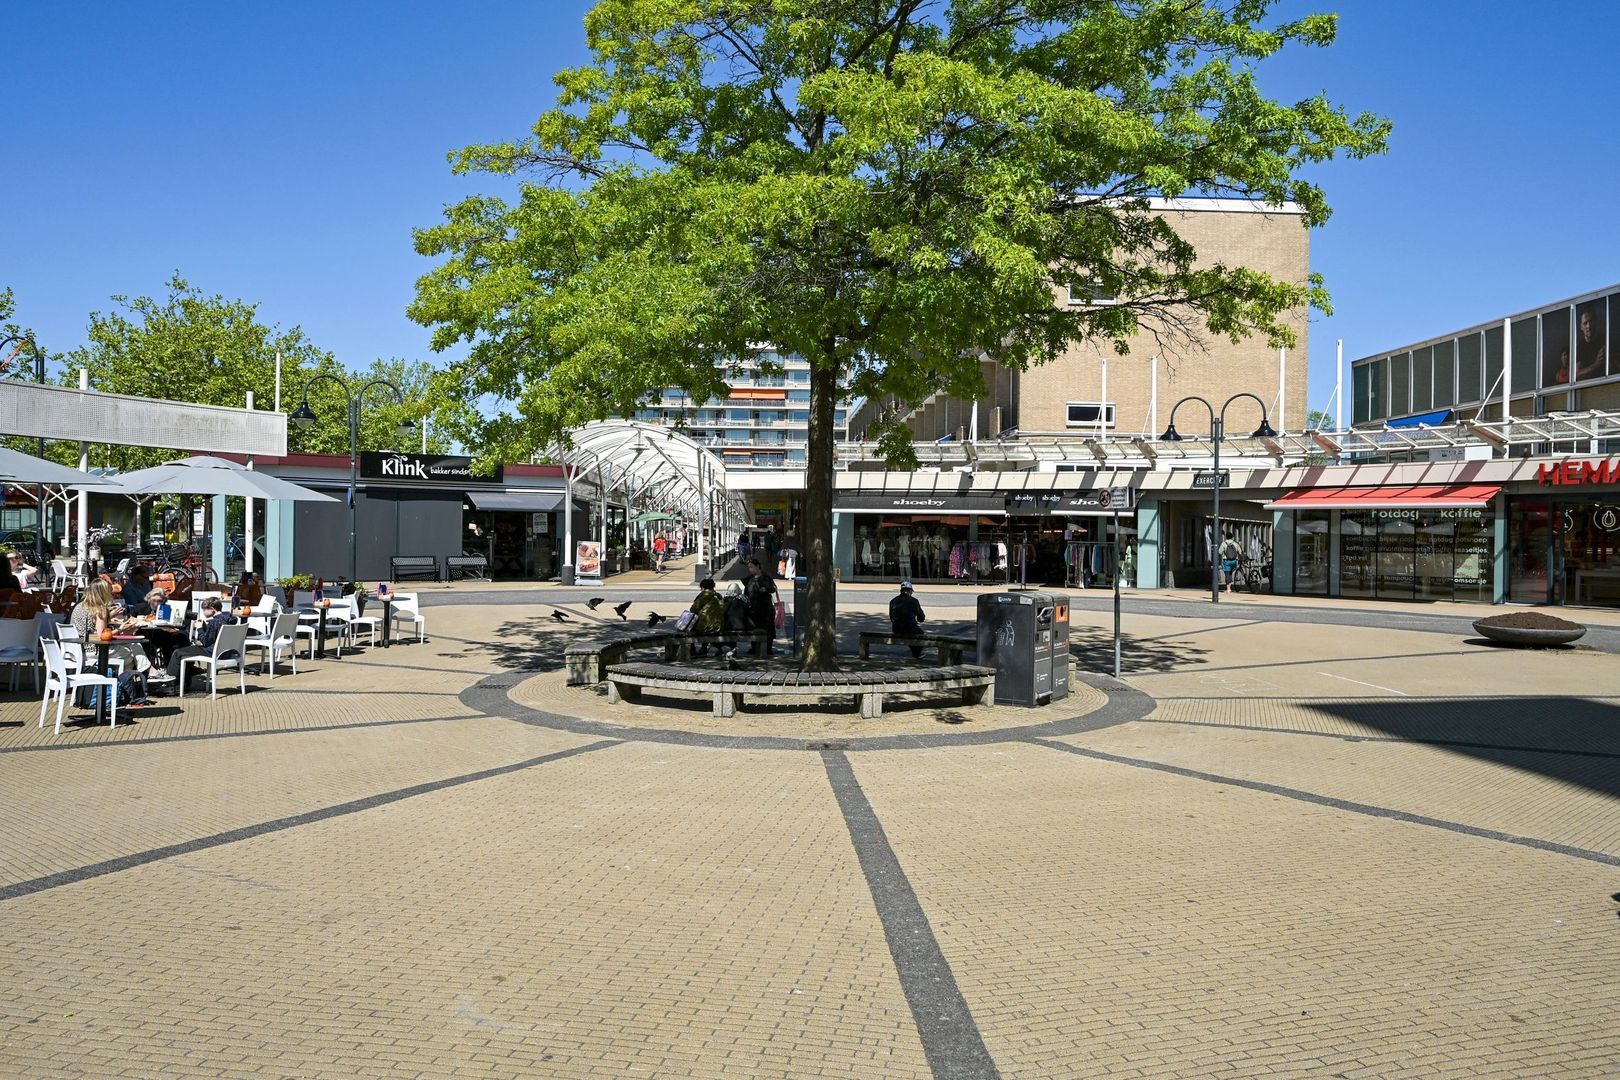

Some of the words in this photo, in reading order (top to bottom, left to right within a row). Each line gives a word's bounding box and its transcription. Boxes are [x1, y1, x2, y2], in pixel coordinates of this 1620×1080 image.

[382, 454, 429, 479] Klink
[430, 466, 450, 475] bakker
[893, 498, 946, 507] shoeby
[1440, 509, 1482, 518] koffie
